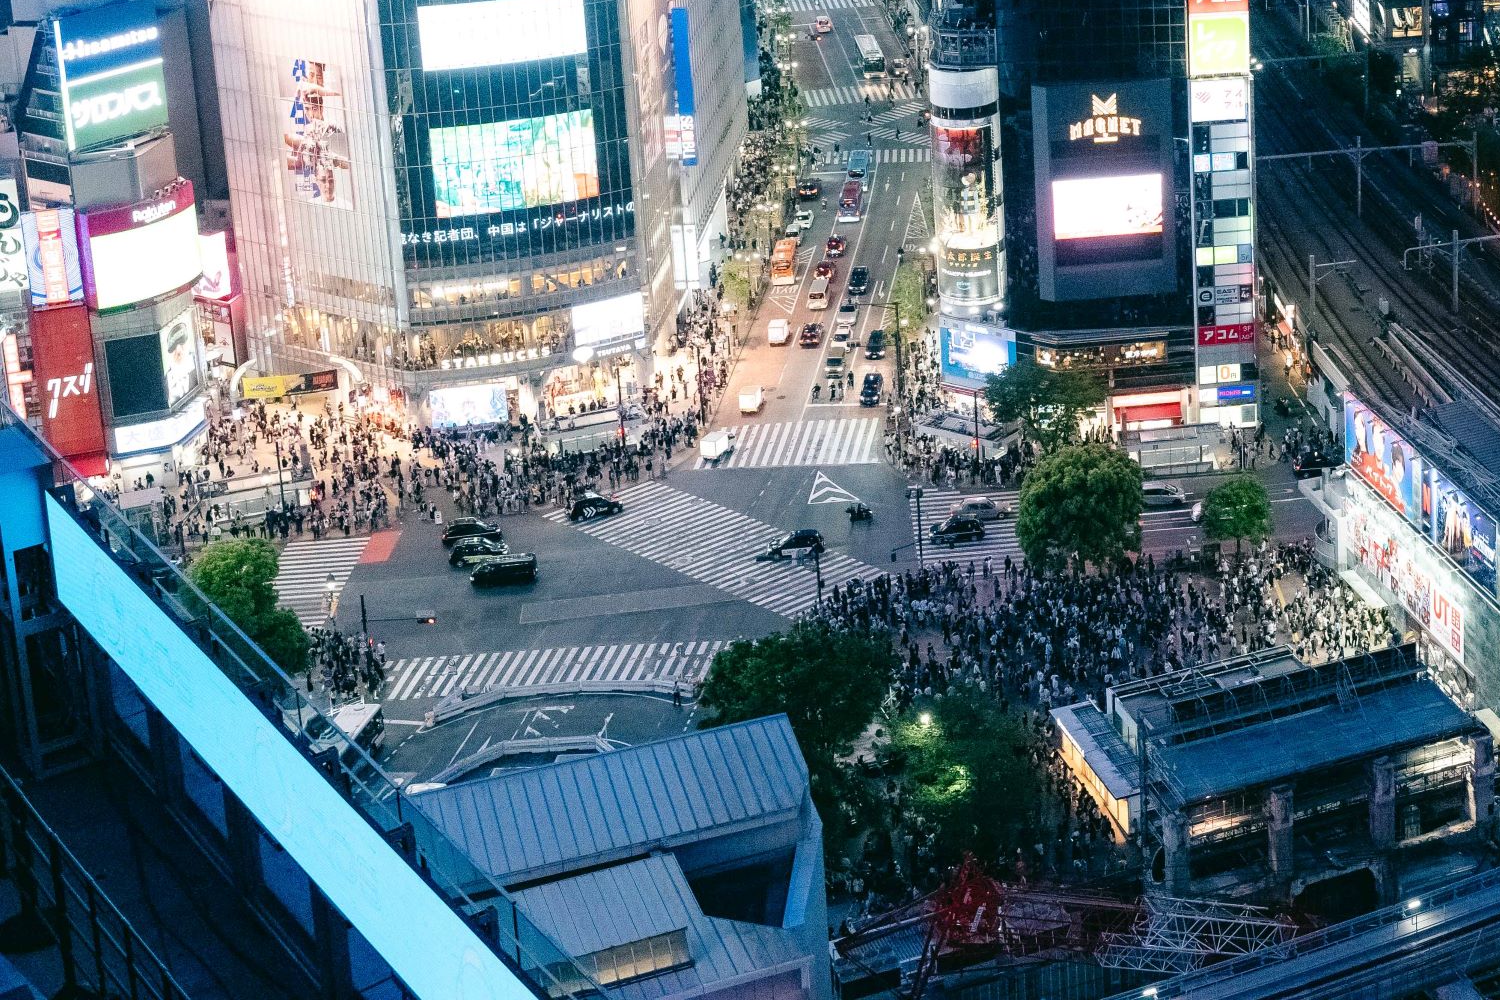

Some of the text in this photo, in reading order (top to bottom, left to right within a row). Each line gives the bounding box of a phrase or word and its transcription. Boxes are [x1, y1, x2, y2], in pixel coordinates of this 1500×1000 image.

[71, 81, 162, 129] サロンパス
[132, 200, 177, 223] Rakuten
[1204, 329, 1239, 341] アコム
[440, 346, 551, 370] STARBUCKS
[597, 344, 632, 357] TSUTAYA
[47, 362, 93, 419] クスリ
[1433, 588, 1450, 627] UT
